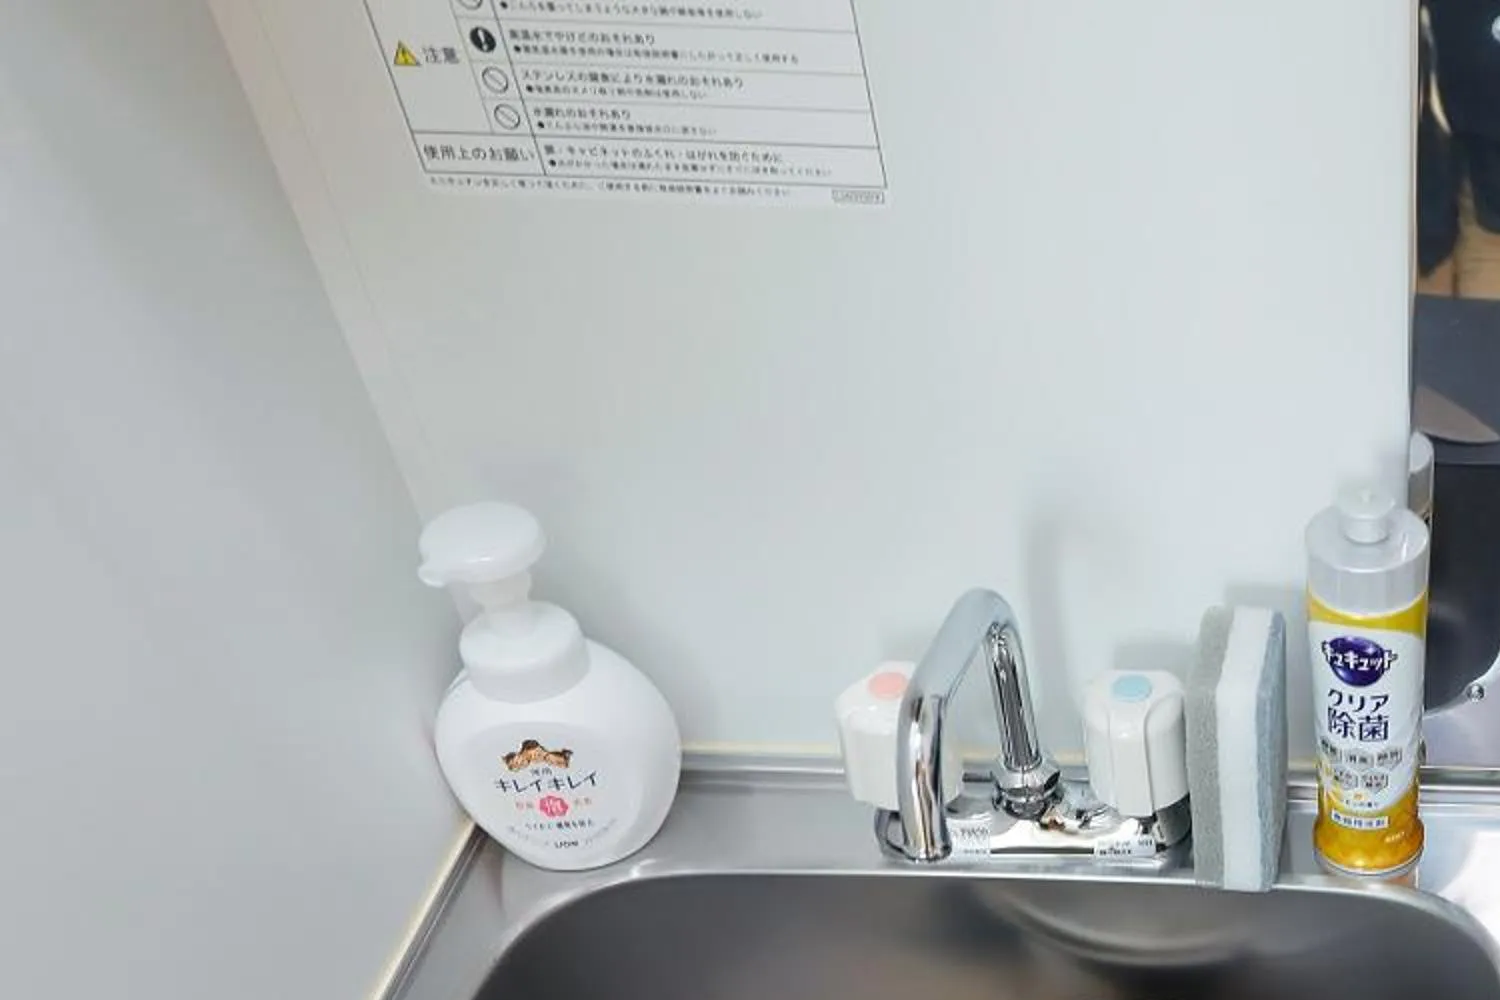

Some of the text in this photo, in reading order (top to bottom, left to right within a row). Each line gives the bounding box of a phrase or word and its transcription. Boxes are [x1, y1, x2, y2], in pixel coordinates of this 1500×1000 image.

[1322, 641, 1398, 671] キュキュット
[1328, 689, 1390, 713] クリア
[1328, 709, 1390, 742] 除菌
[495, 771, 597, 793] キレイキレイ
